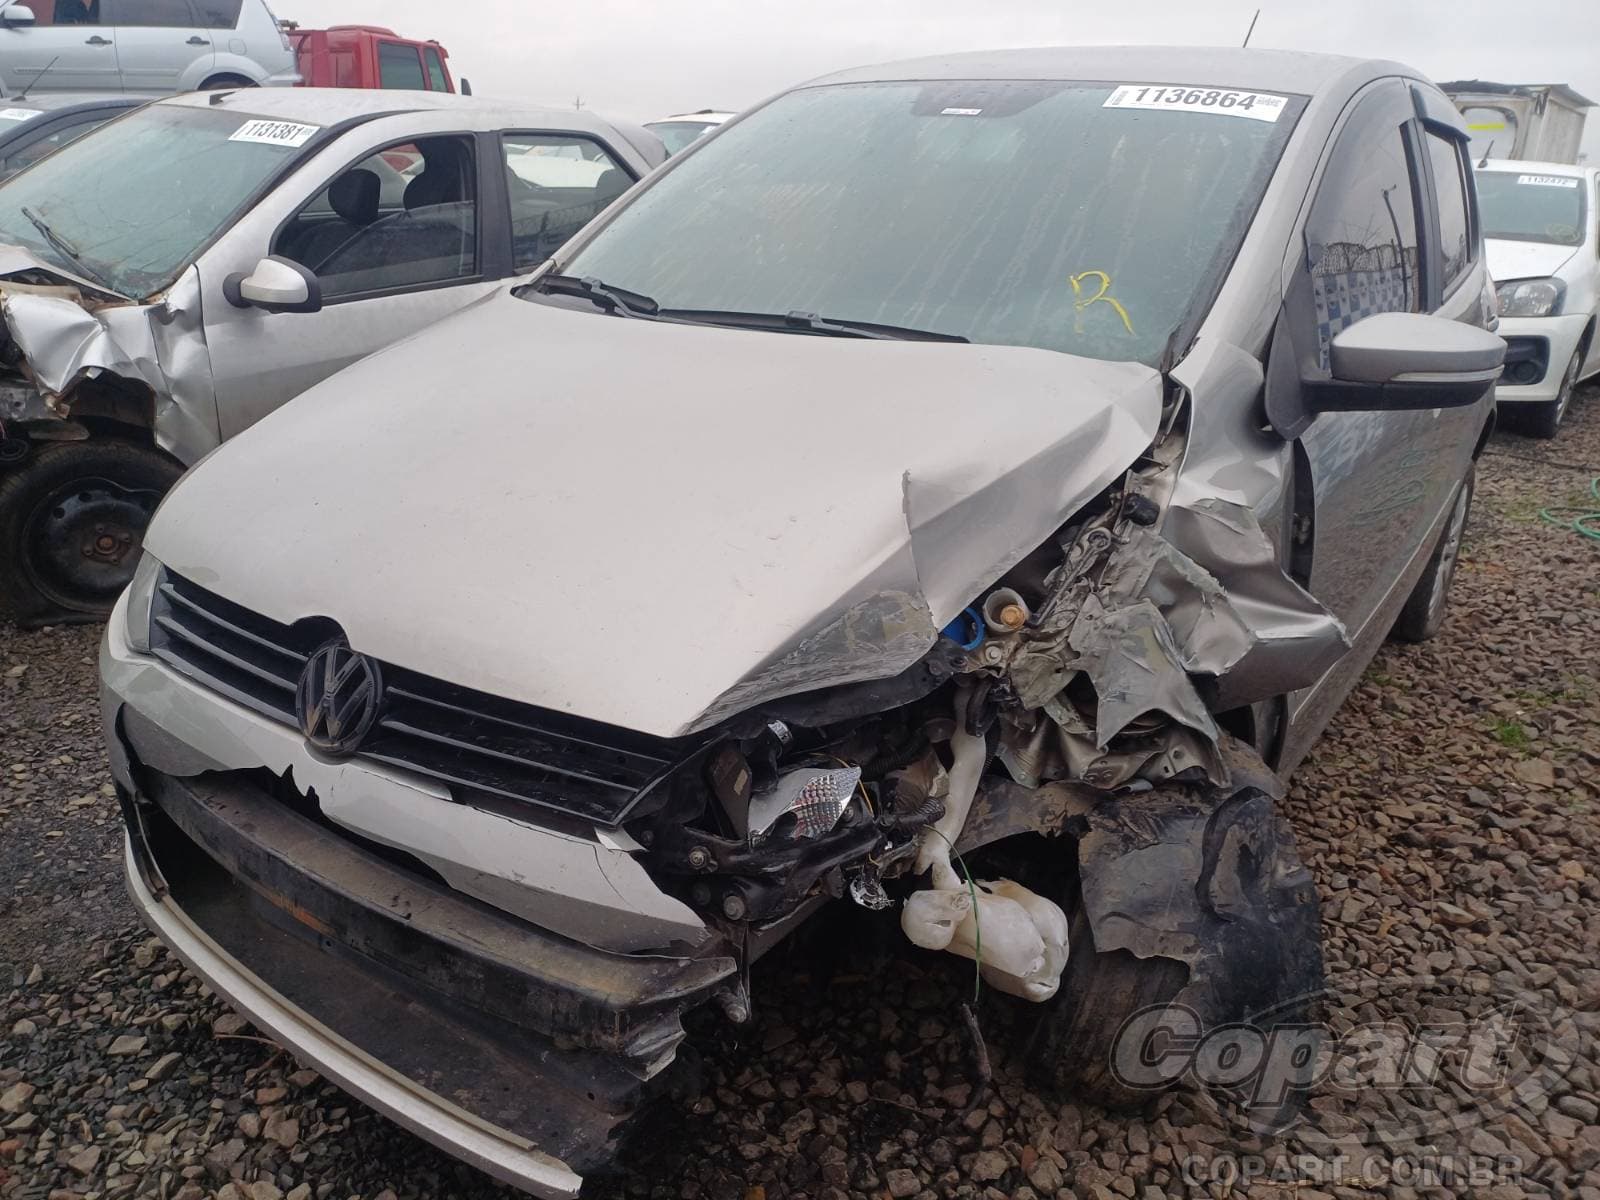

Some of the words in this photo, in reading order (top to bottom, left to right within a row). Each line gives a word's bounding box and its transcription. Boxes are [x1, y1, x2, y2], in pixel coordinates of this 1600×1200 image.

[1134, 87, 1257, 110] 1136864
[246, 122, 305, 141] 1131381
[1070, 270, 1136, 336] R
